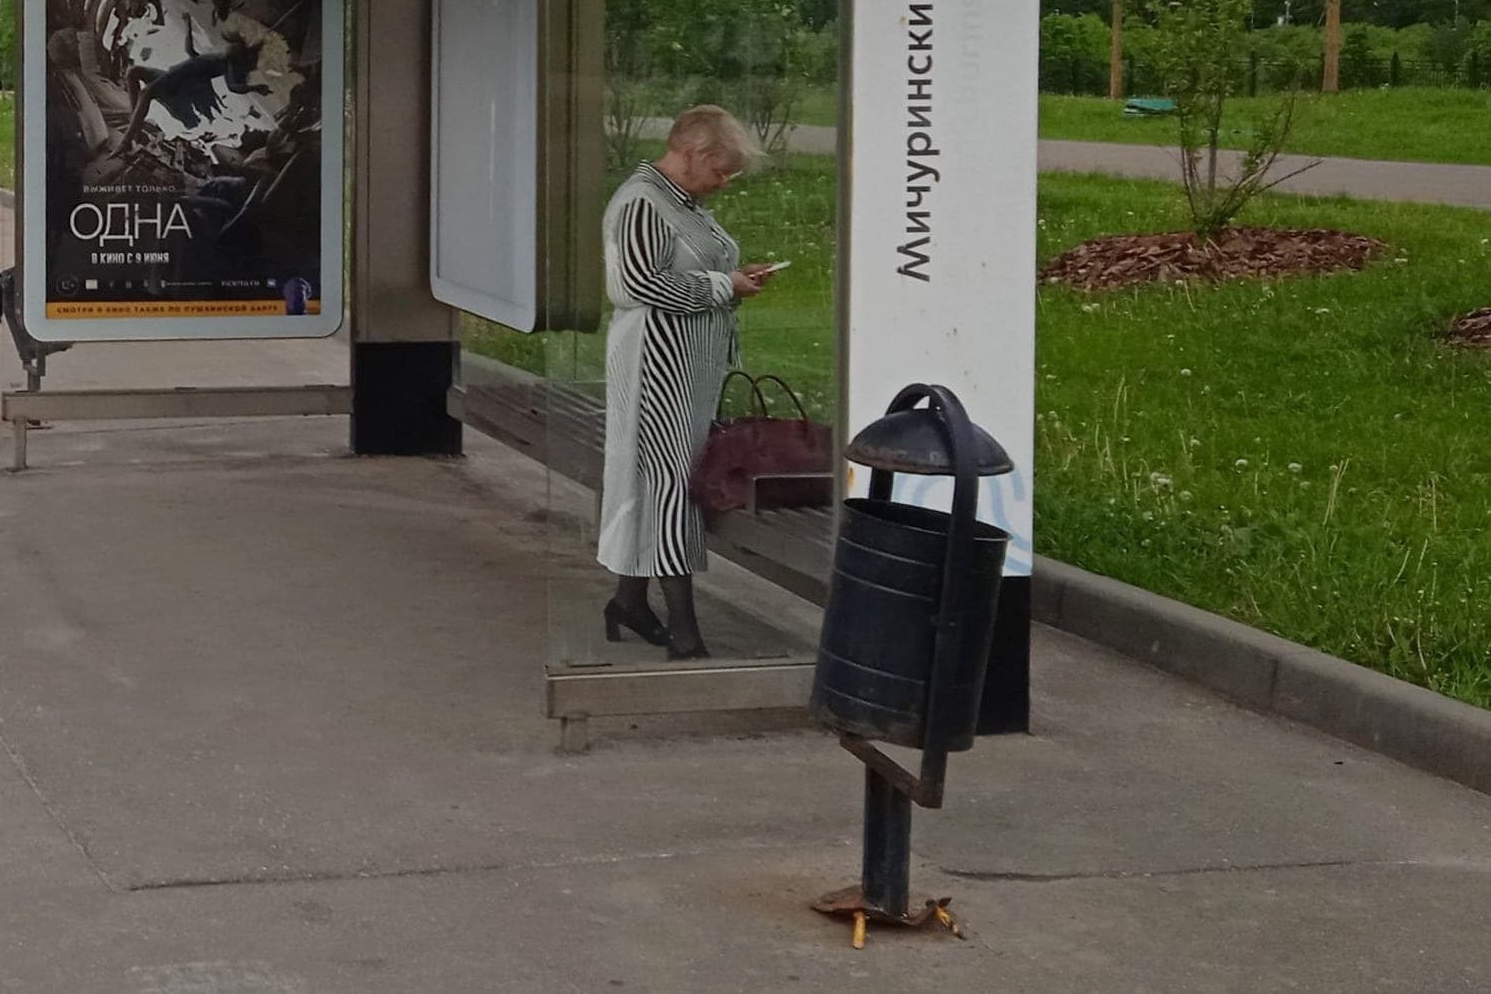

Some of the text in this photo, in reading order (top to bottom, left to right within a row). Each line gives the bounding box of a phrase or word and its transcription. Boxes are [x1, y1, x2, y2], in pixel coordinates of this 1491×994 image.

[83, 185, 176, 193] ВЫЖИВЕТ ТОЛЬКО
[69, 202, 193, 247] ОДНА
[91, 252, 169, 264] В КИНО С 9 ИЮНЯ
